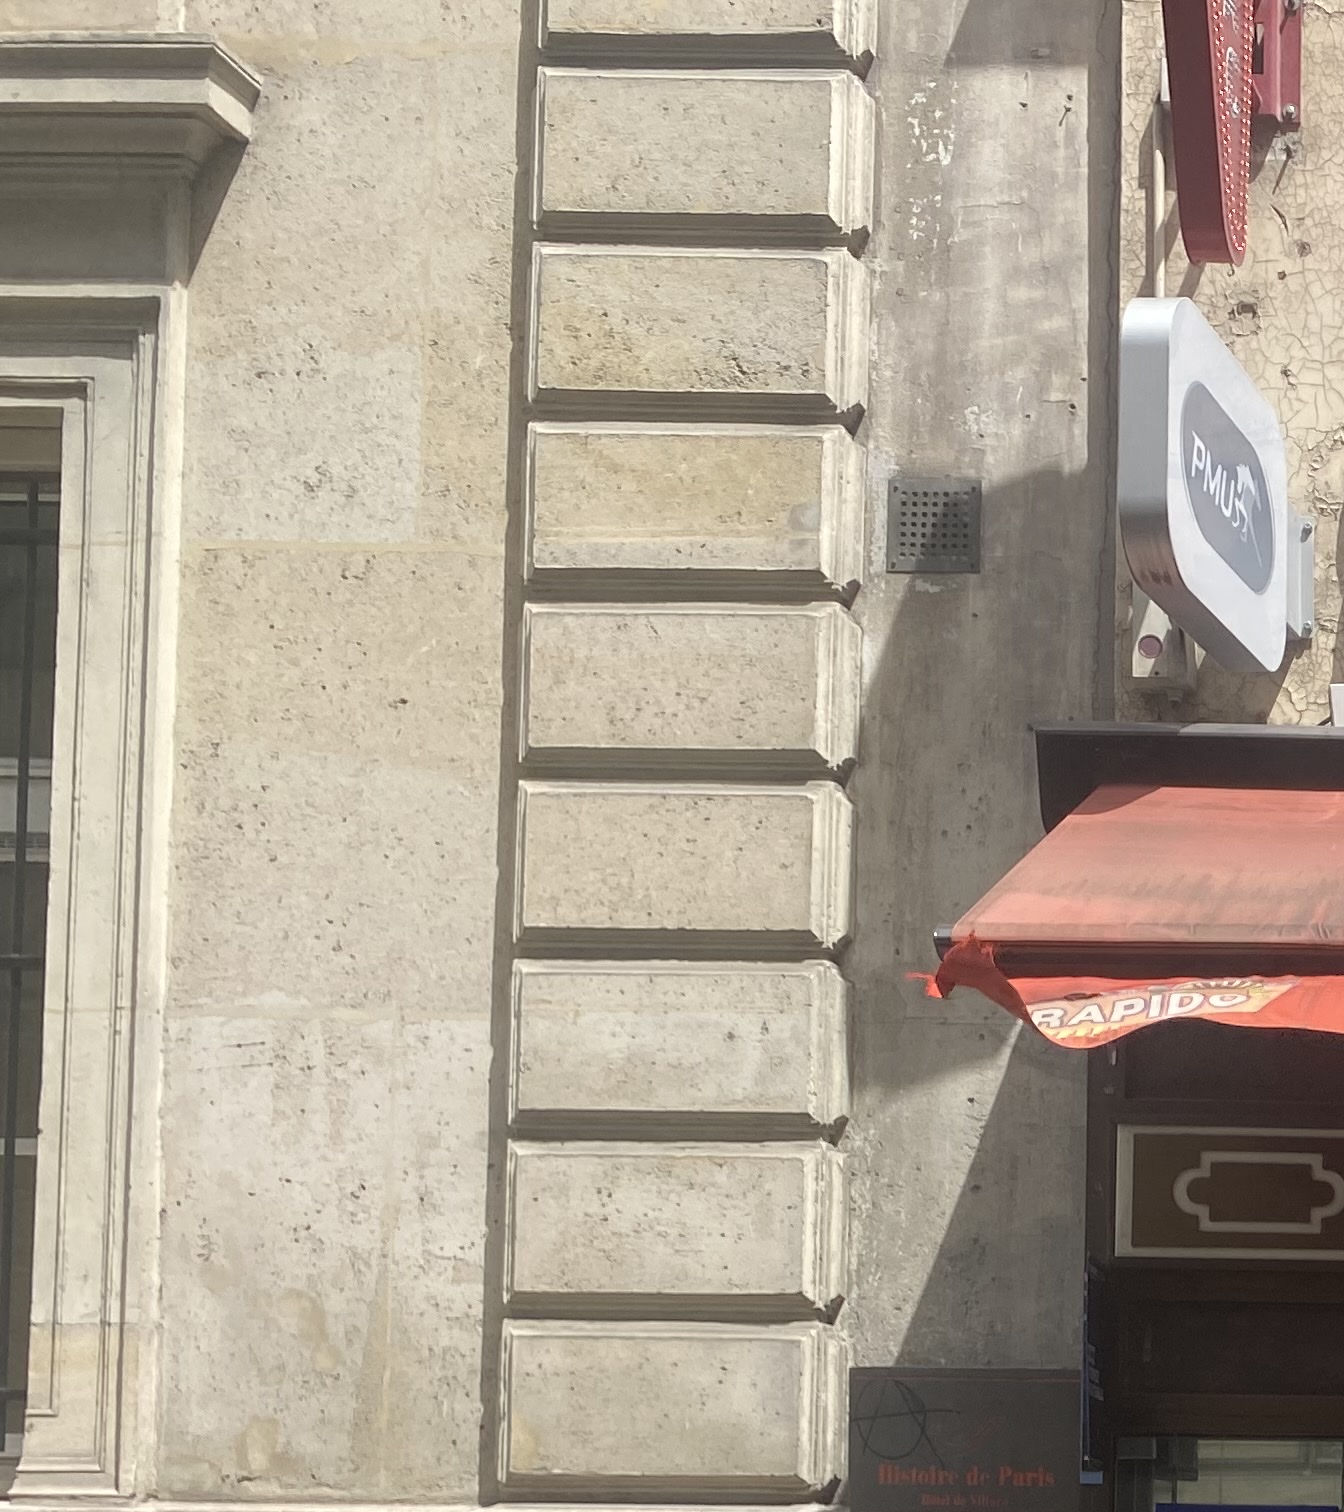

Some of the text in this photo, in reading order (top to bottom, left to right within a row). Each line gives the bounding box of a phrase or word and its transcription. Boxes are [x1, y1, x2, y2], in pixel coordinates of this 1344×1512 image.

[1191, 430, 1236, 518] PMU
[1029, 990, 1250, 1029] RAPIDO
[878, 1462, 1056, 1488] Histoire de Paris
